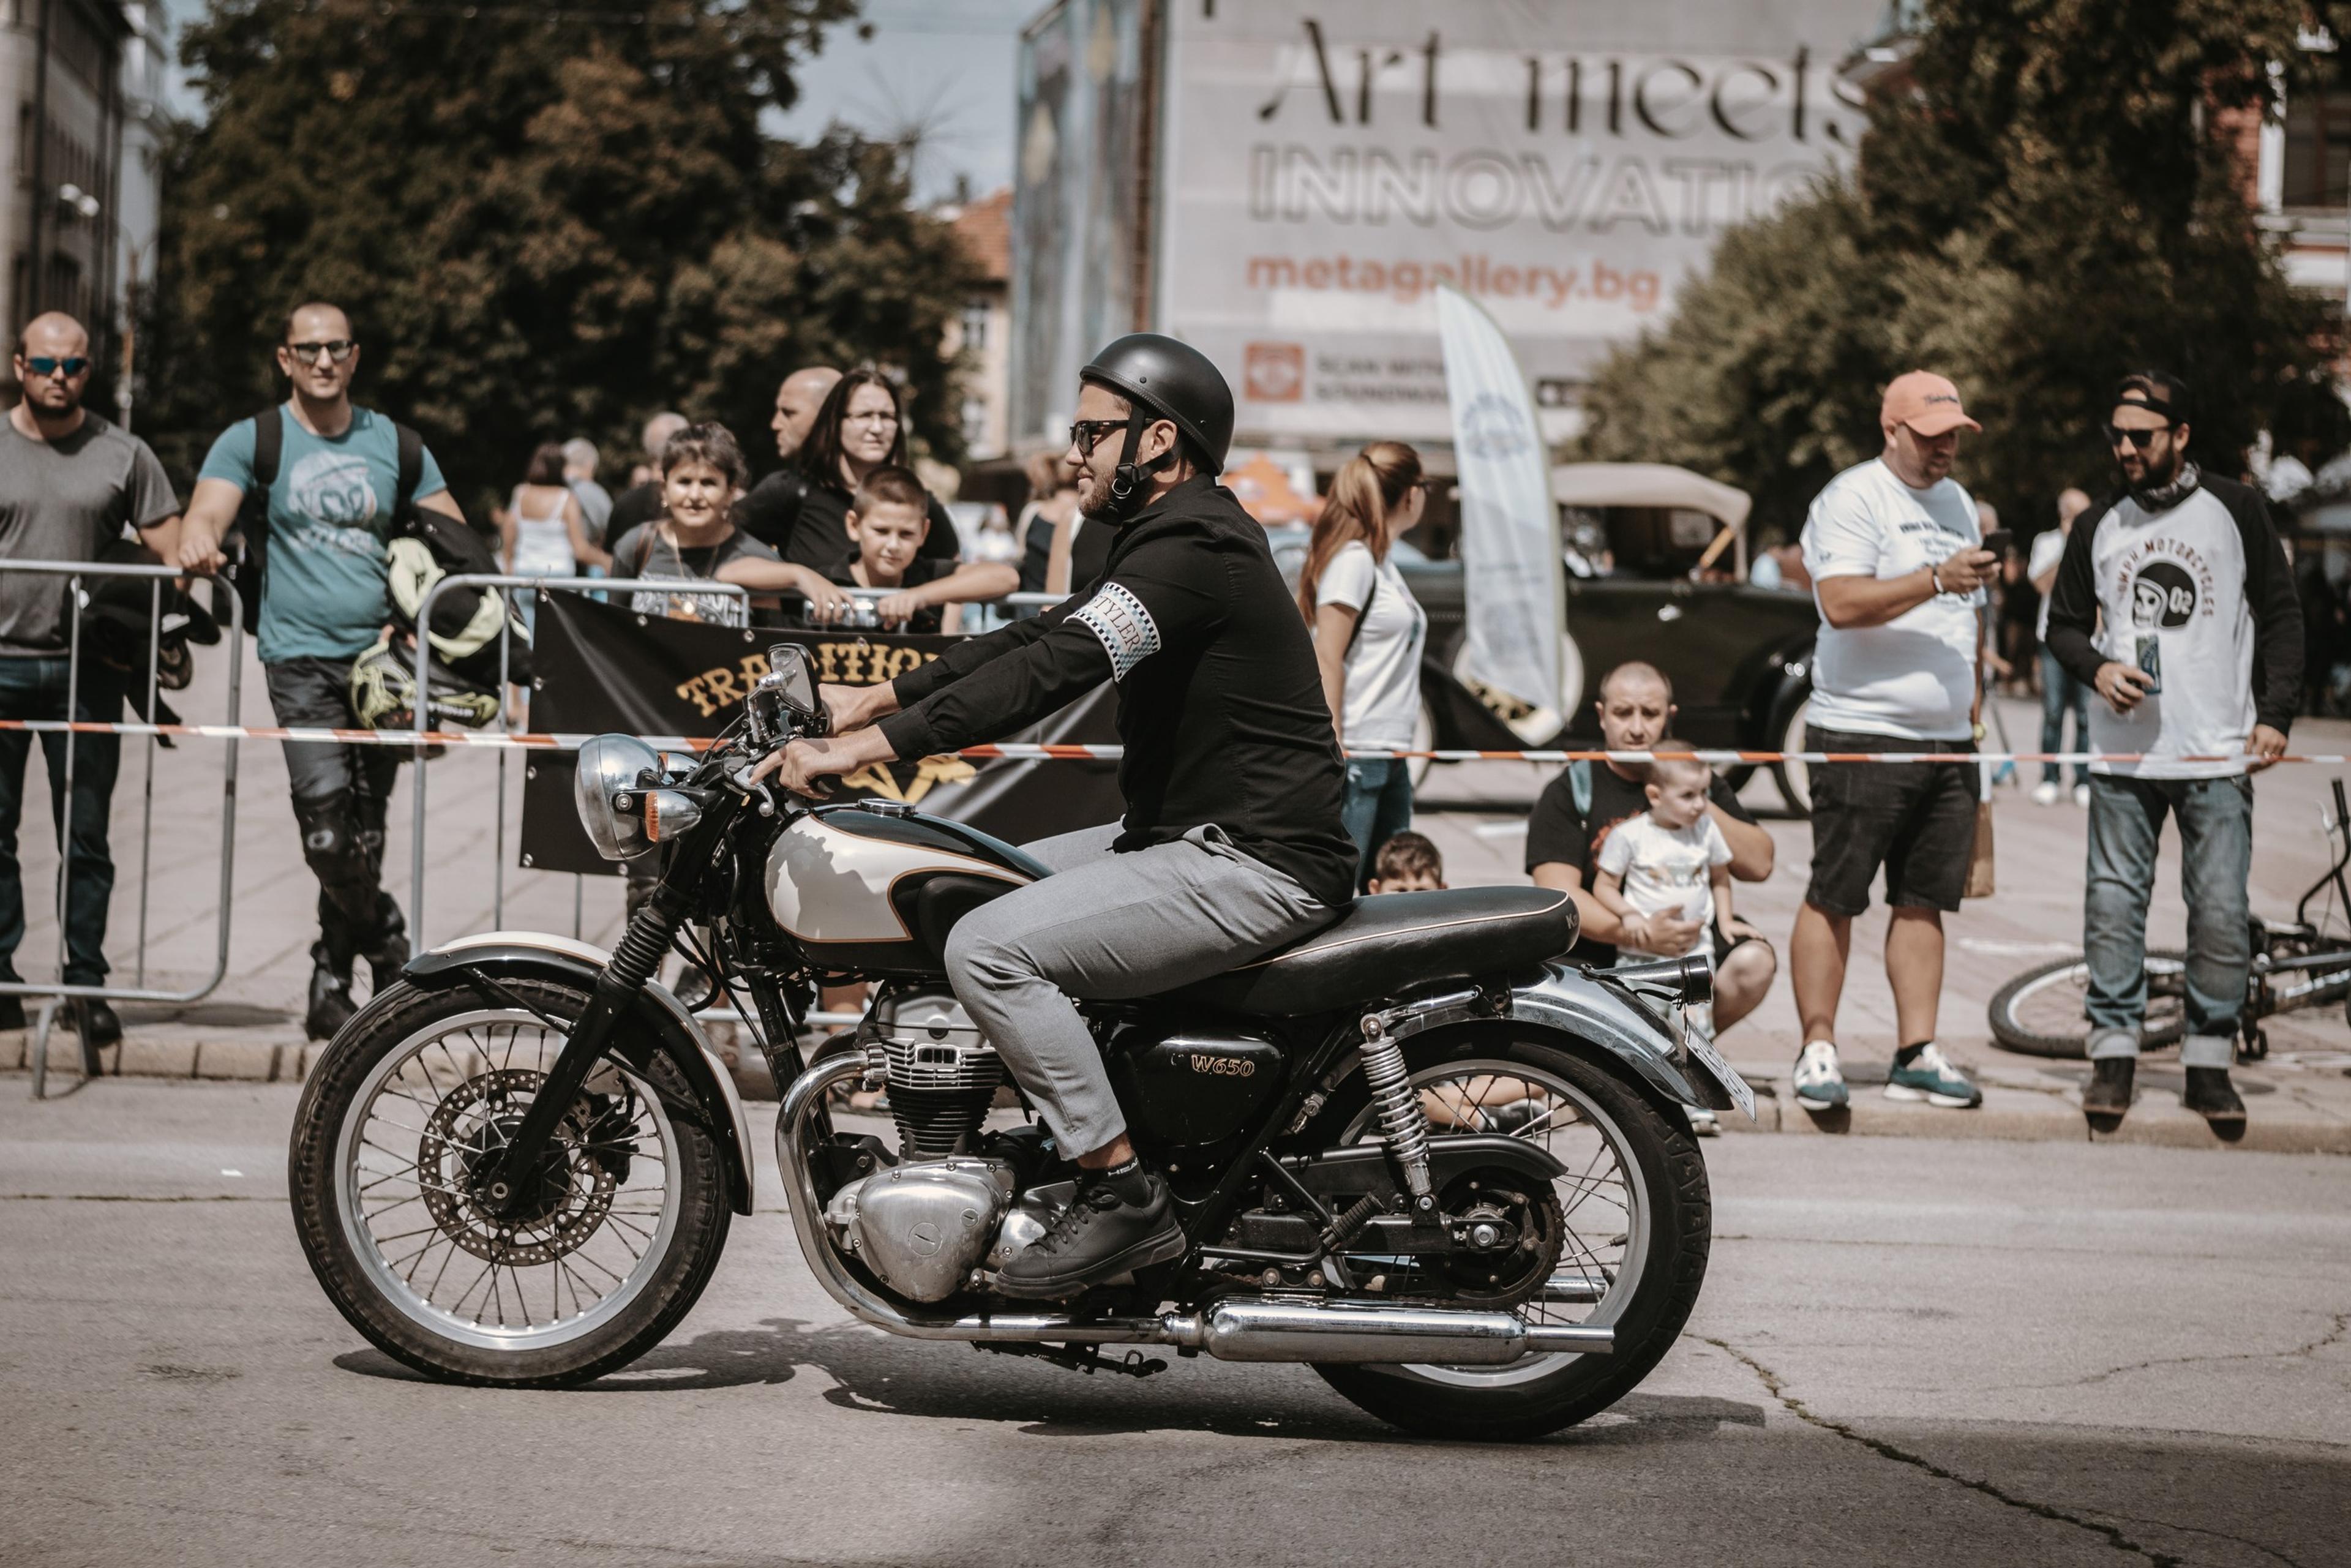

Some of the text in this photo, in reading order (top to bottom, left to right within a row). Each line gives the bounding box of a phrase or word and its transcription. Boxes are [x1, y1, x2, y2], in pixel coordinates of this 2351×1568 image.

[1256, 15, 1870, 151] Art meets
[1245, 250, 1661, 311] metagallery.bg
[2169, 586, 2194, 615] 02
[676, 642, 940, 718] TRAITIO
[1191, 1053, 1255, 1077] W650
